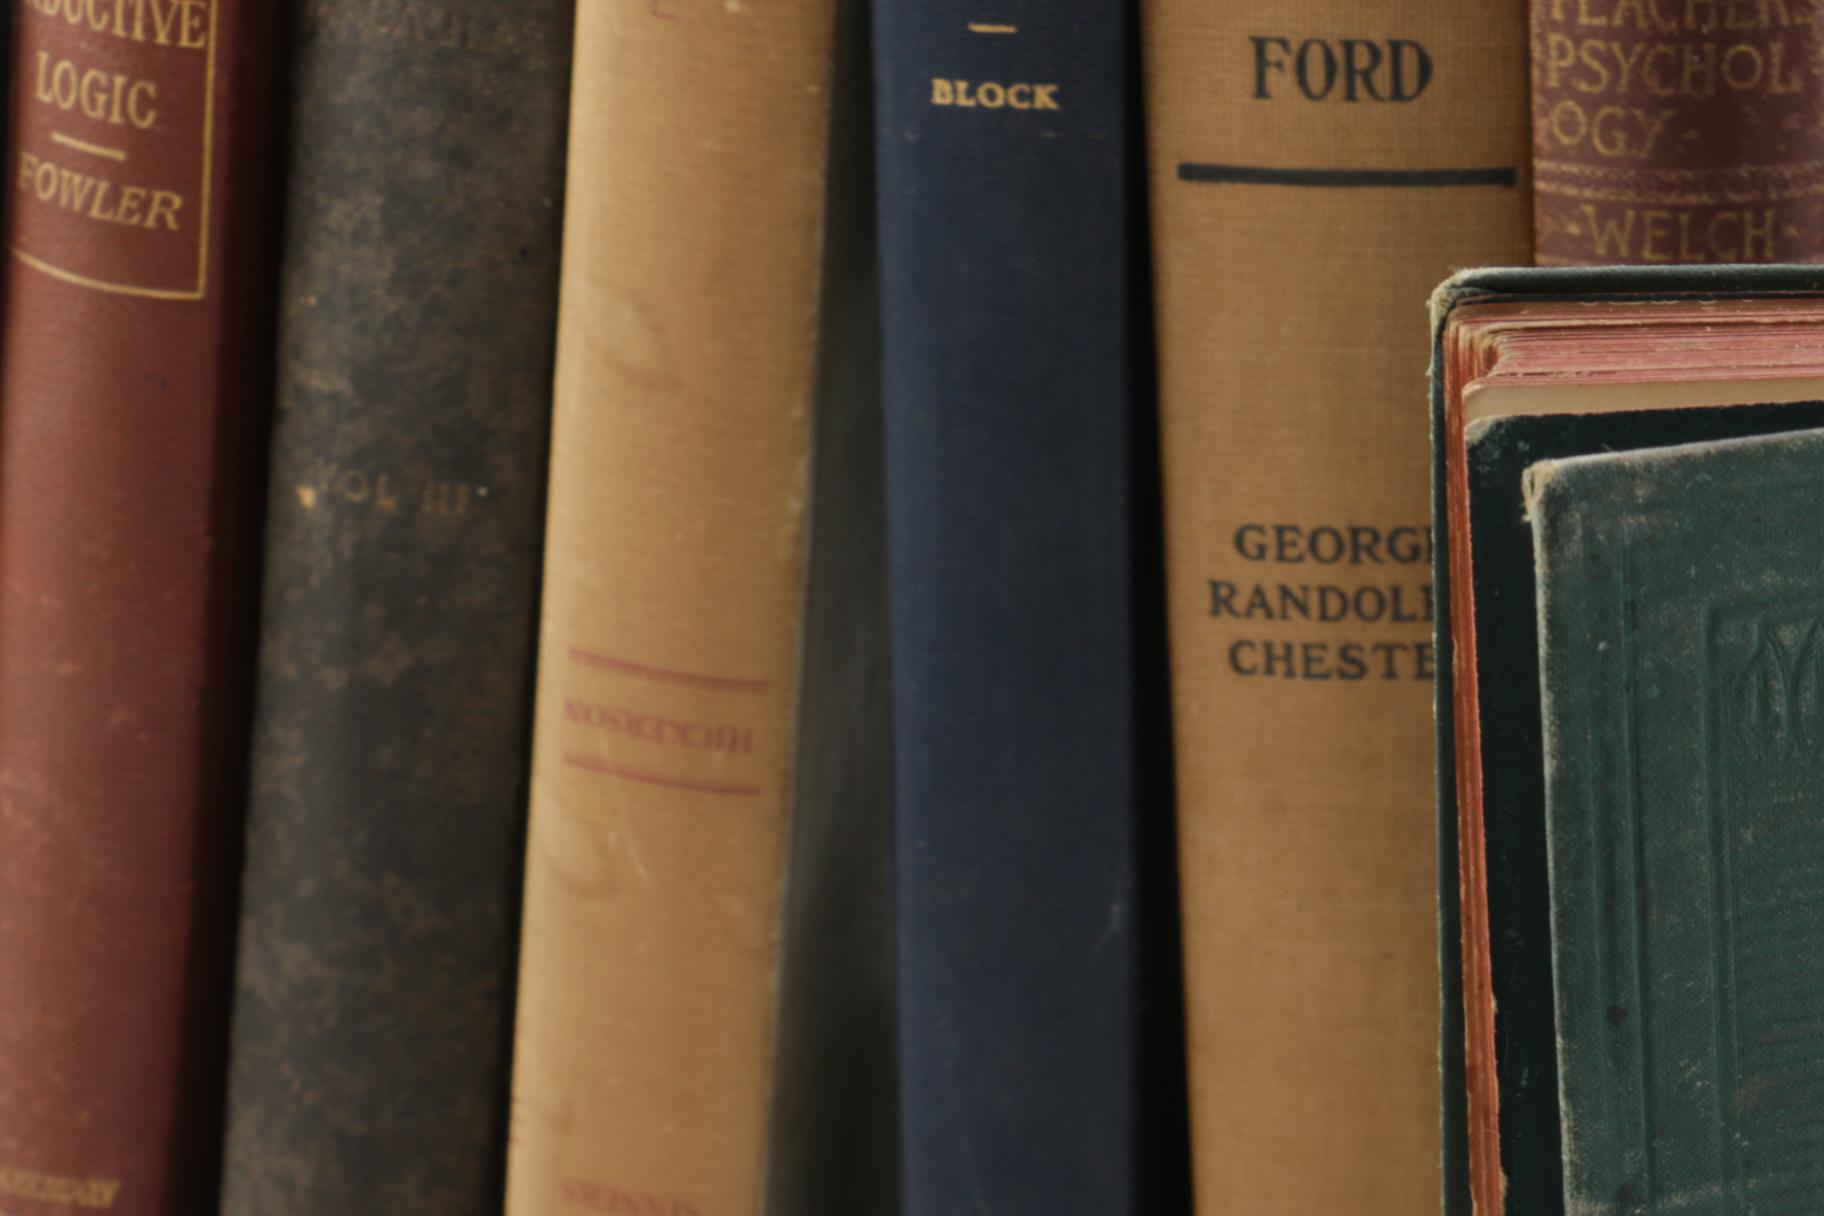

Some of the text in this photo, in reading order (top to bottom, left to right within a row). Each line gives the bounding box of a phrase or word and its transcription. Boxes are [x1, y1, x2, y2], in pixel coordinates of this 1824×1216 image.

[36, 50, 158, 129] LOGIC
[930, 78, 1060, 110] BLOCK
[1248, 35, 1434, 103] FORD
[17, 152, 183, 231] FOWLER
[1233, 522, 1433, 565] GEORG
